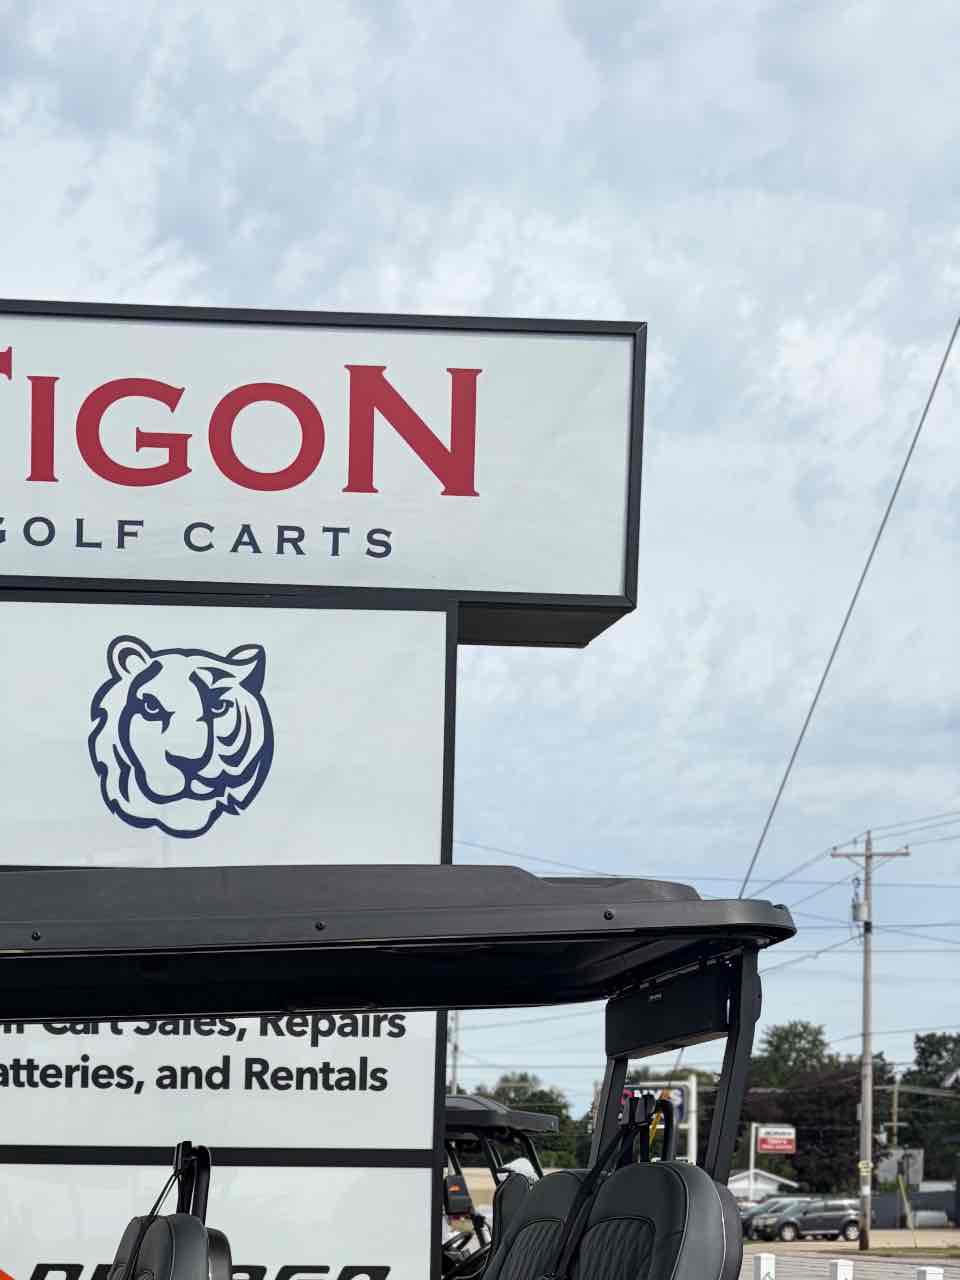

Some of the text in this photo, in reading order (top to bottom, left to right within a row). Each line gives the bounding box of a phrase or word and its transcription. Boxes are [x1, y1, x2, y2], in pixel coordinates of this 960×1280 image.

[183, 520, 393, 559] CARTS
[259, 1013, 407, 1047] Repairs
[155, 1055, 231, 1091] and
[244, 1056, 389, 1092] Rentals
